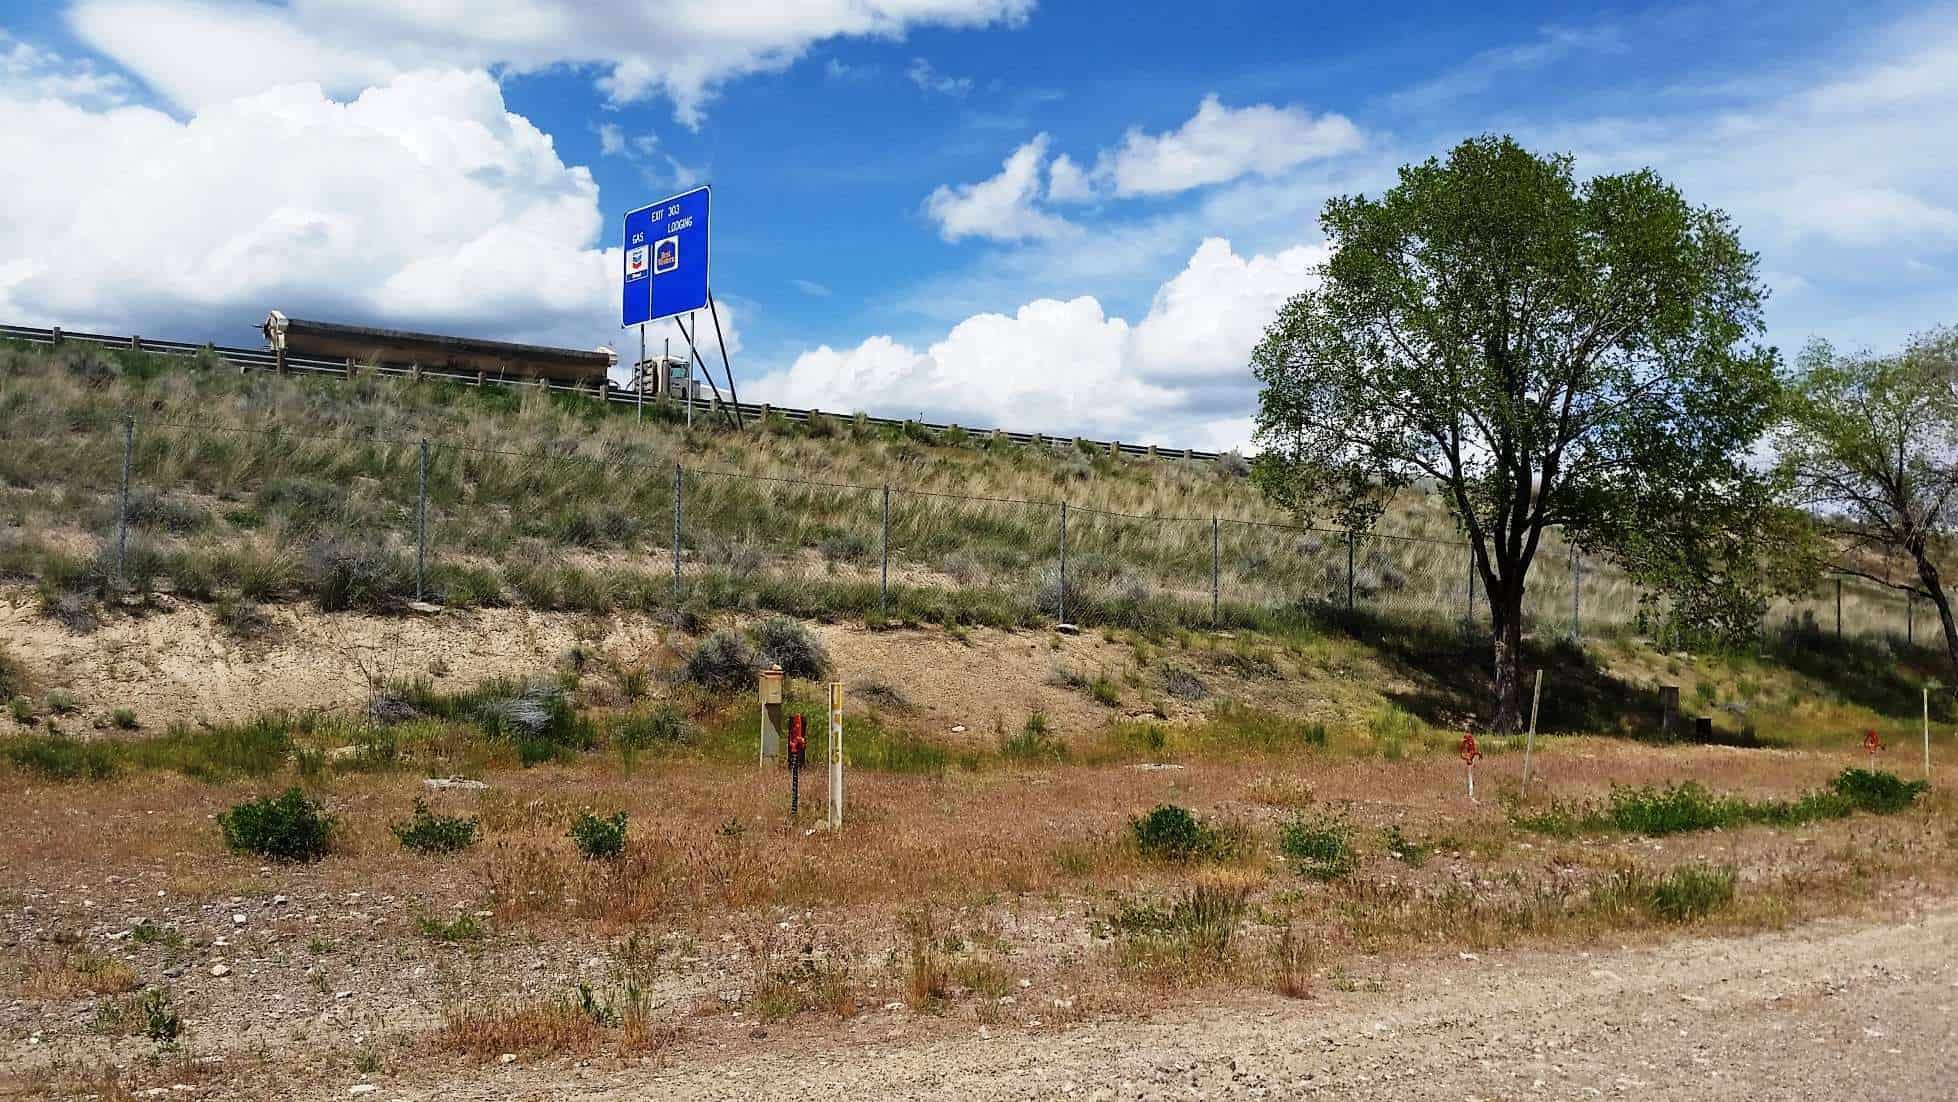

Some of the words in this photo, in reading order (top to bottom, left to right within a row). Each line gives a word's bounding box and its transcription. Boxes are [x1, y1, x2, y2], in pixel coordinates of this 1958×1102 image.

[651, 210, 664, 222] EXIT
[667, 216, 693, 233] LODGING
[632, 231, 644, 244] GAS
